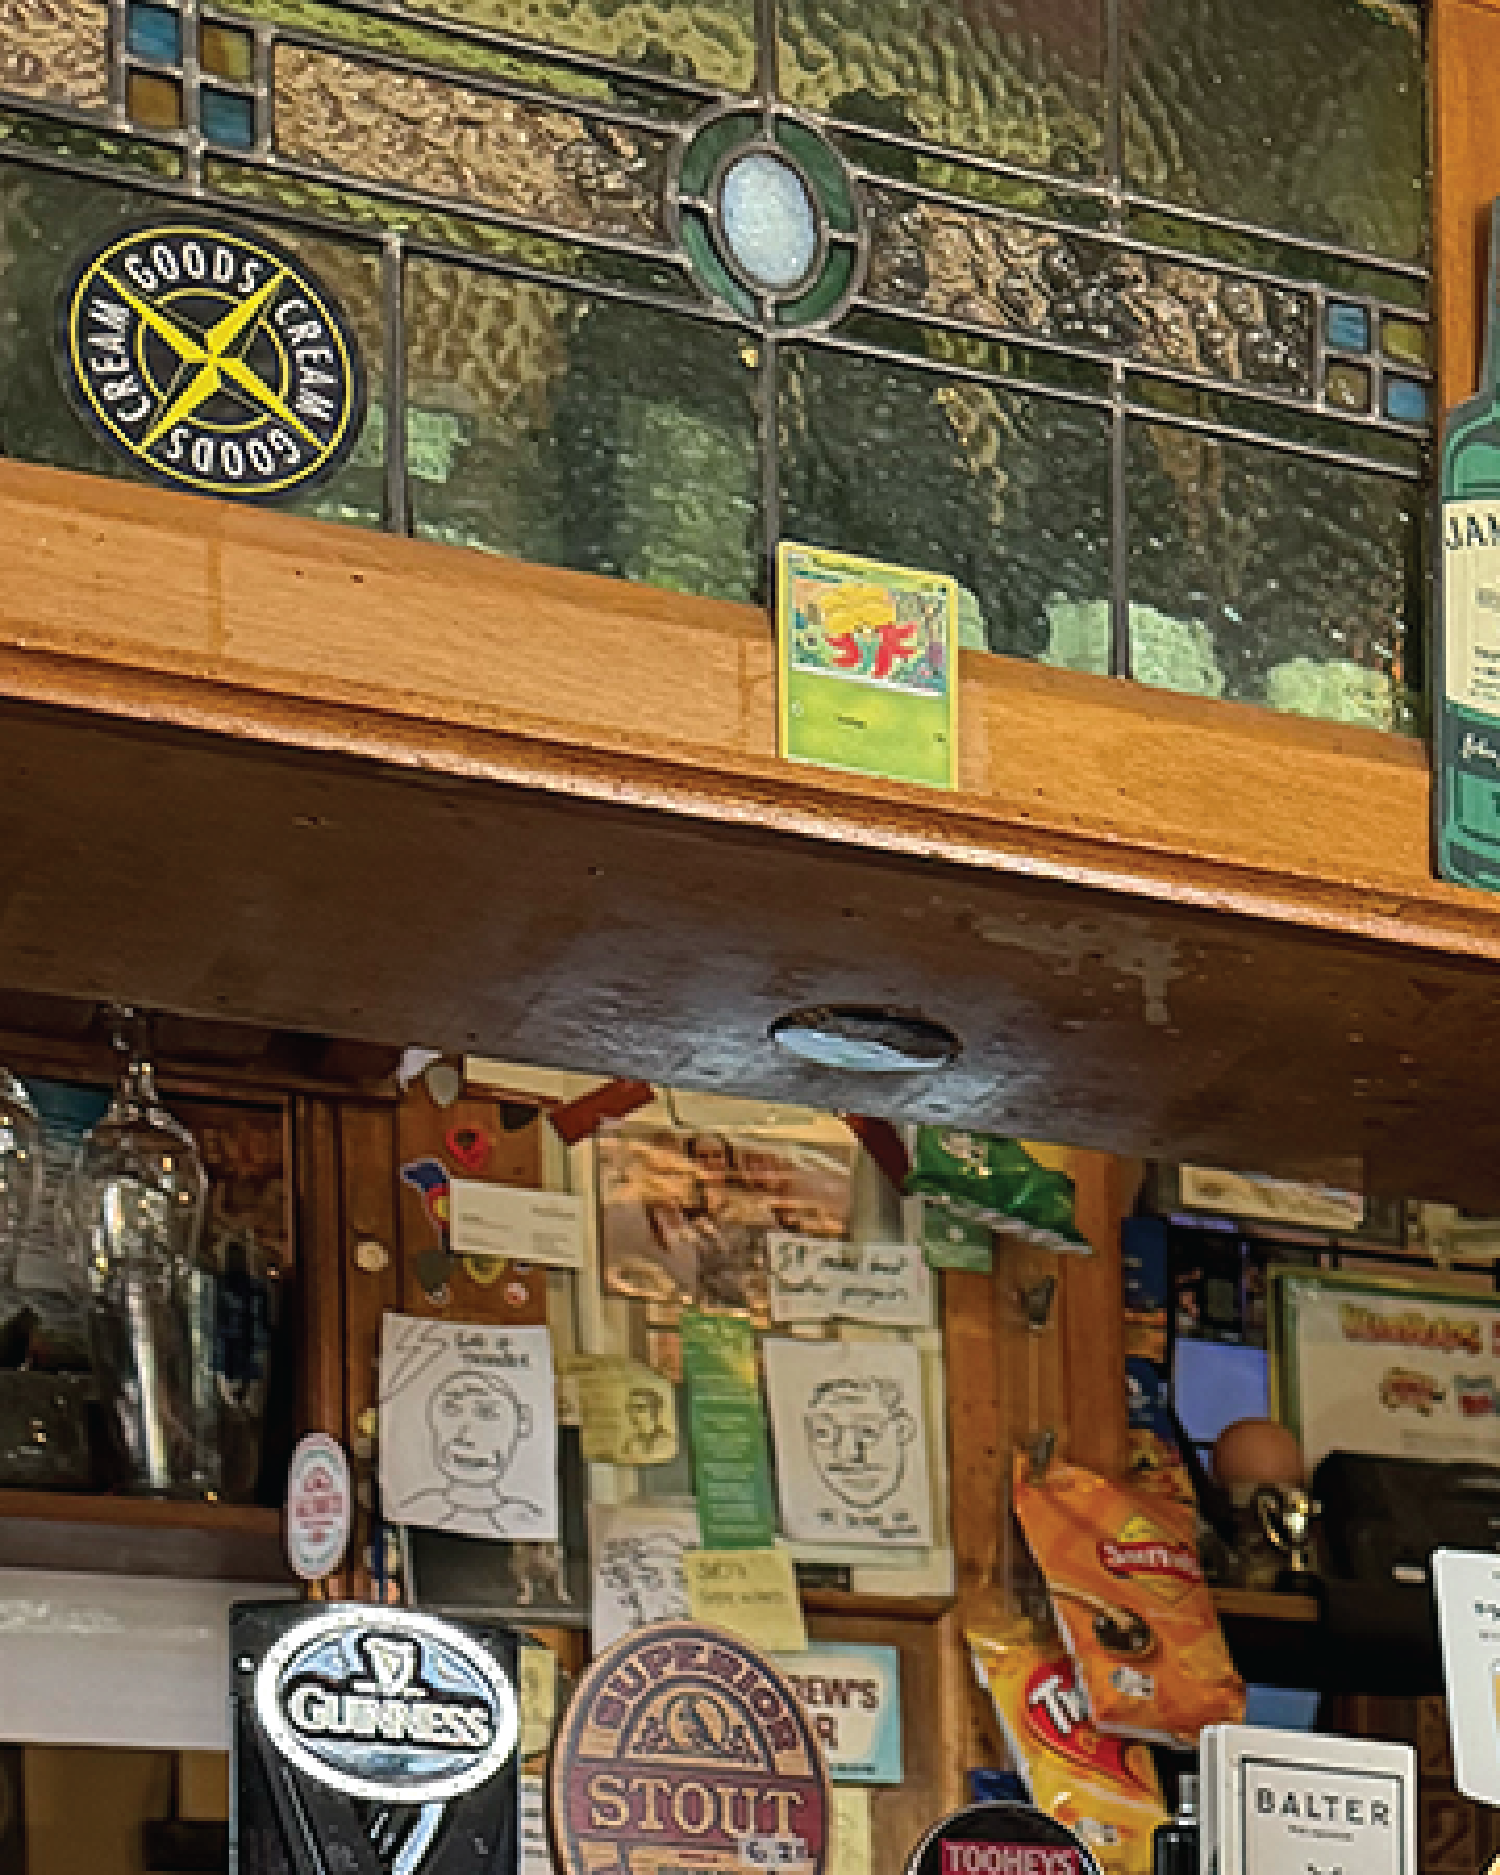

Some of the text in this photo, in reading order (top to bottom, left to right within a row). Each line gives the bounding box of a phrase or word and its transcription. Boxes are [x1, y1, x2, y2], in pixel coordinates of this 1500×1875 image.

[124, 242, 262, 294] GOODS
[91, 297, 153, 424] CREAM
[273, 295, 335, 422] CREAM
[165, 427, 303, 480] GOODS
[286, 1685, 490, 1749] GUINNESS
[594, 1640, 800, 1753] SUPERIOR
[588, 1774, 804, 1840] STOUT
[1256, 1787, 1391, 1827] BALTER
